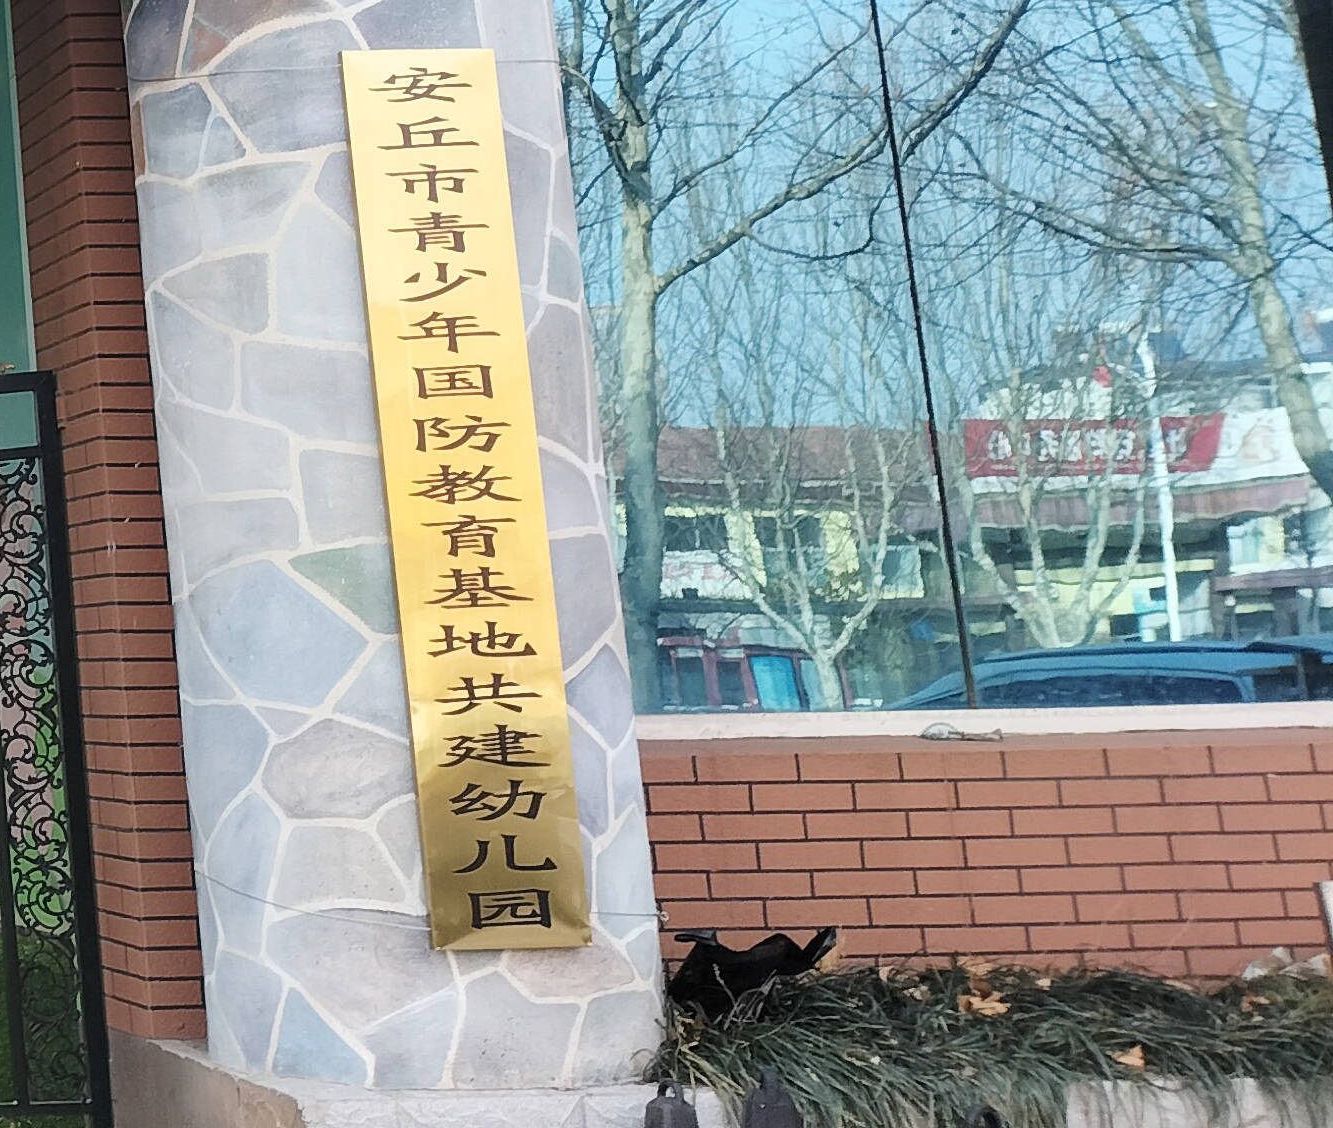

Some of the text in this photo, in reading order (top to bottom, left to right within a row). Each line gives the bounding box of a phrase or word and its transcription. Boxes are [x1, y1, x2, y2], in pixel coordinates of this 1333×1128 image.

[368, 66, 555, 930] 安丘市青少年国防教育基地共建幼儿园
